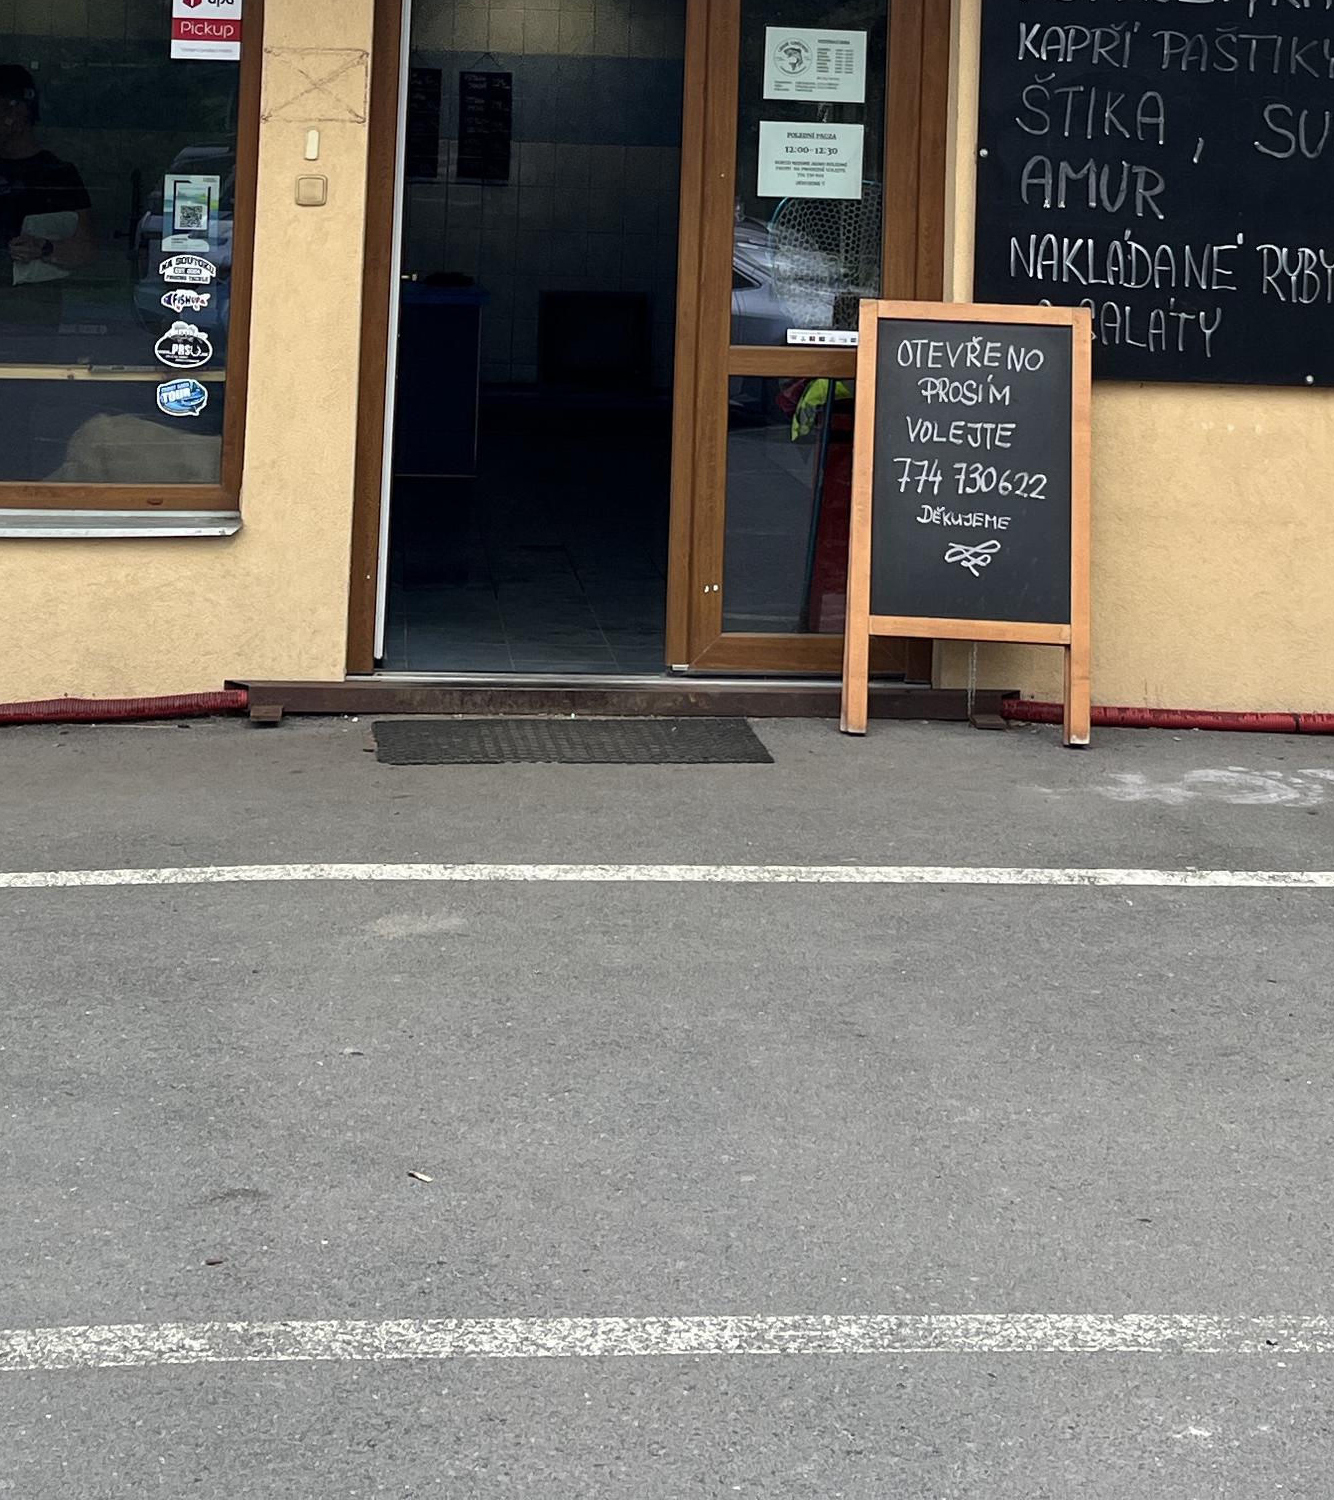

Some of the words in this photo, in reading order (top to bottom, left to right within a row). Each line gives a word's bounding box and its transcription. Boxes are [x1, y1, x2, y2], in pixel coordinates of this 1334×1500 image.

[180, 21, 234, 38] Pickup
[1020, 155, 1166, 220] AMUR
[1010, 228, 1244, 291] NAKLÁDANÉ
[897, 336, 1045, 373] OTEVŘENO
[917, 374, 1011, 406] PROSÍM
[905, 415, 1017, 450] VOLEJTE
[892, 457, 943, 496] 774
[916, 504, 1012, 531] DĚKUJEME
